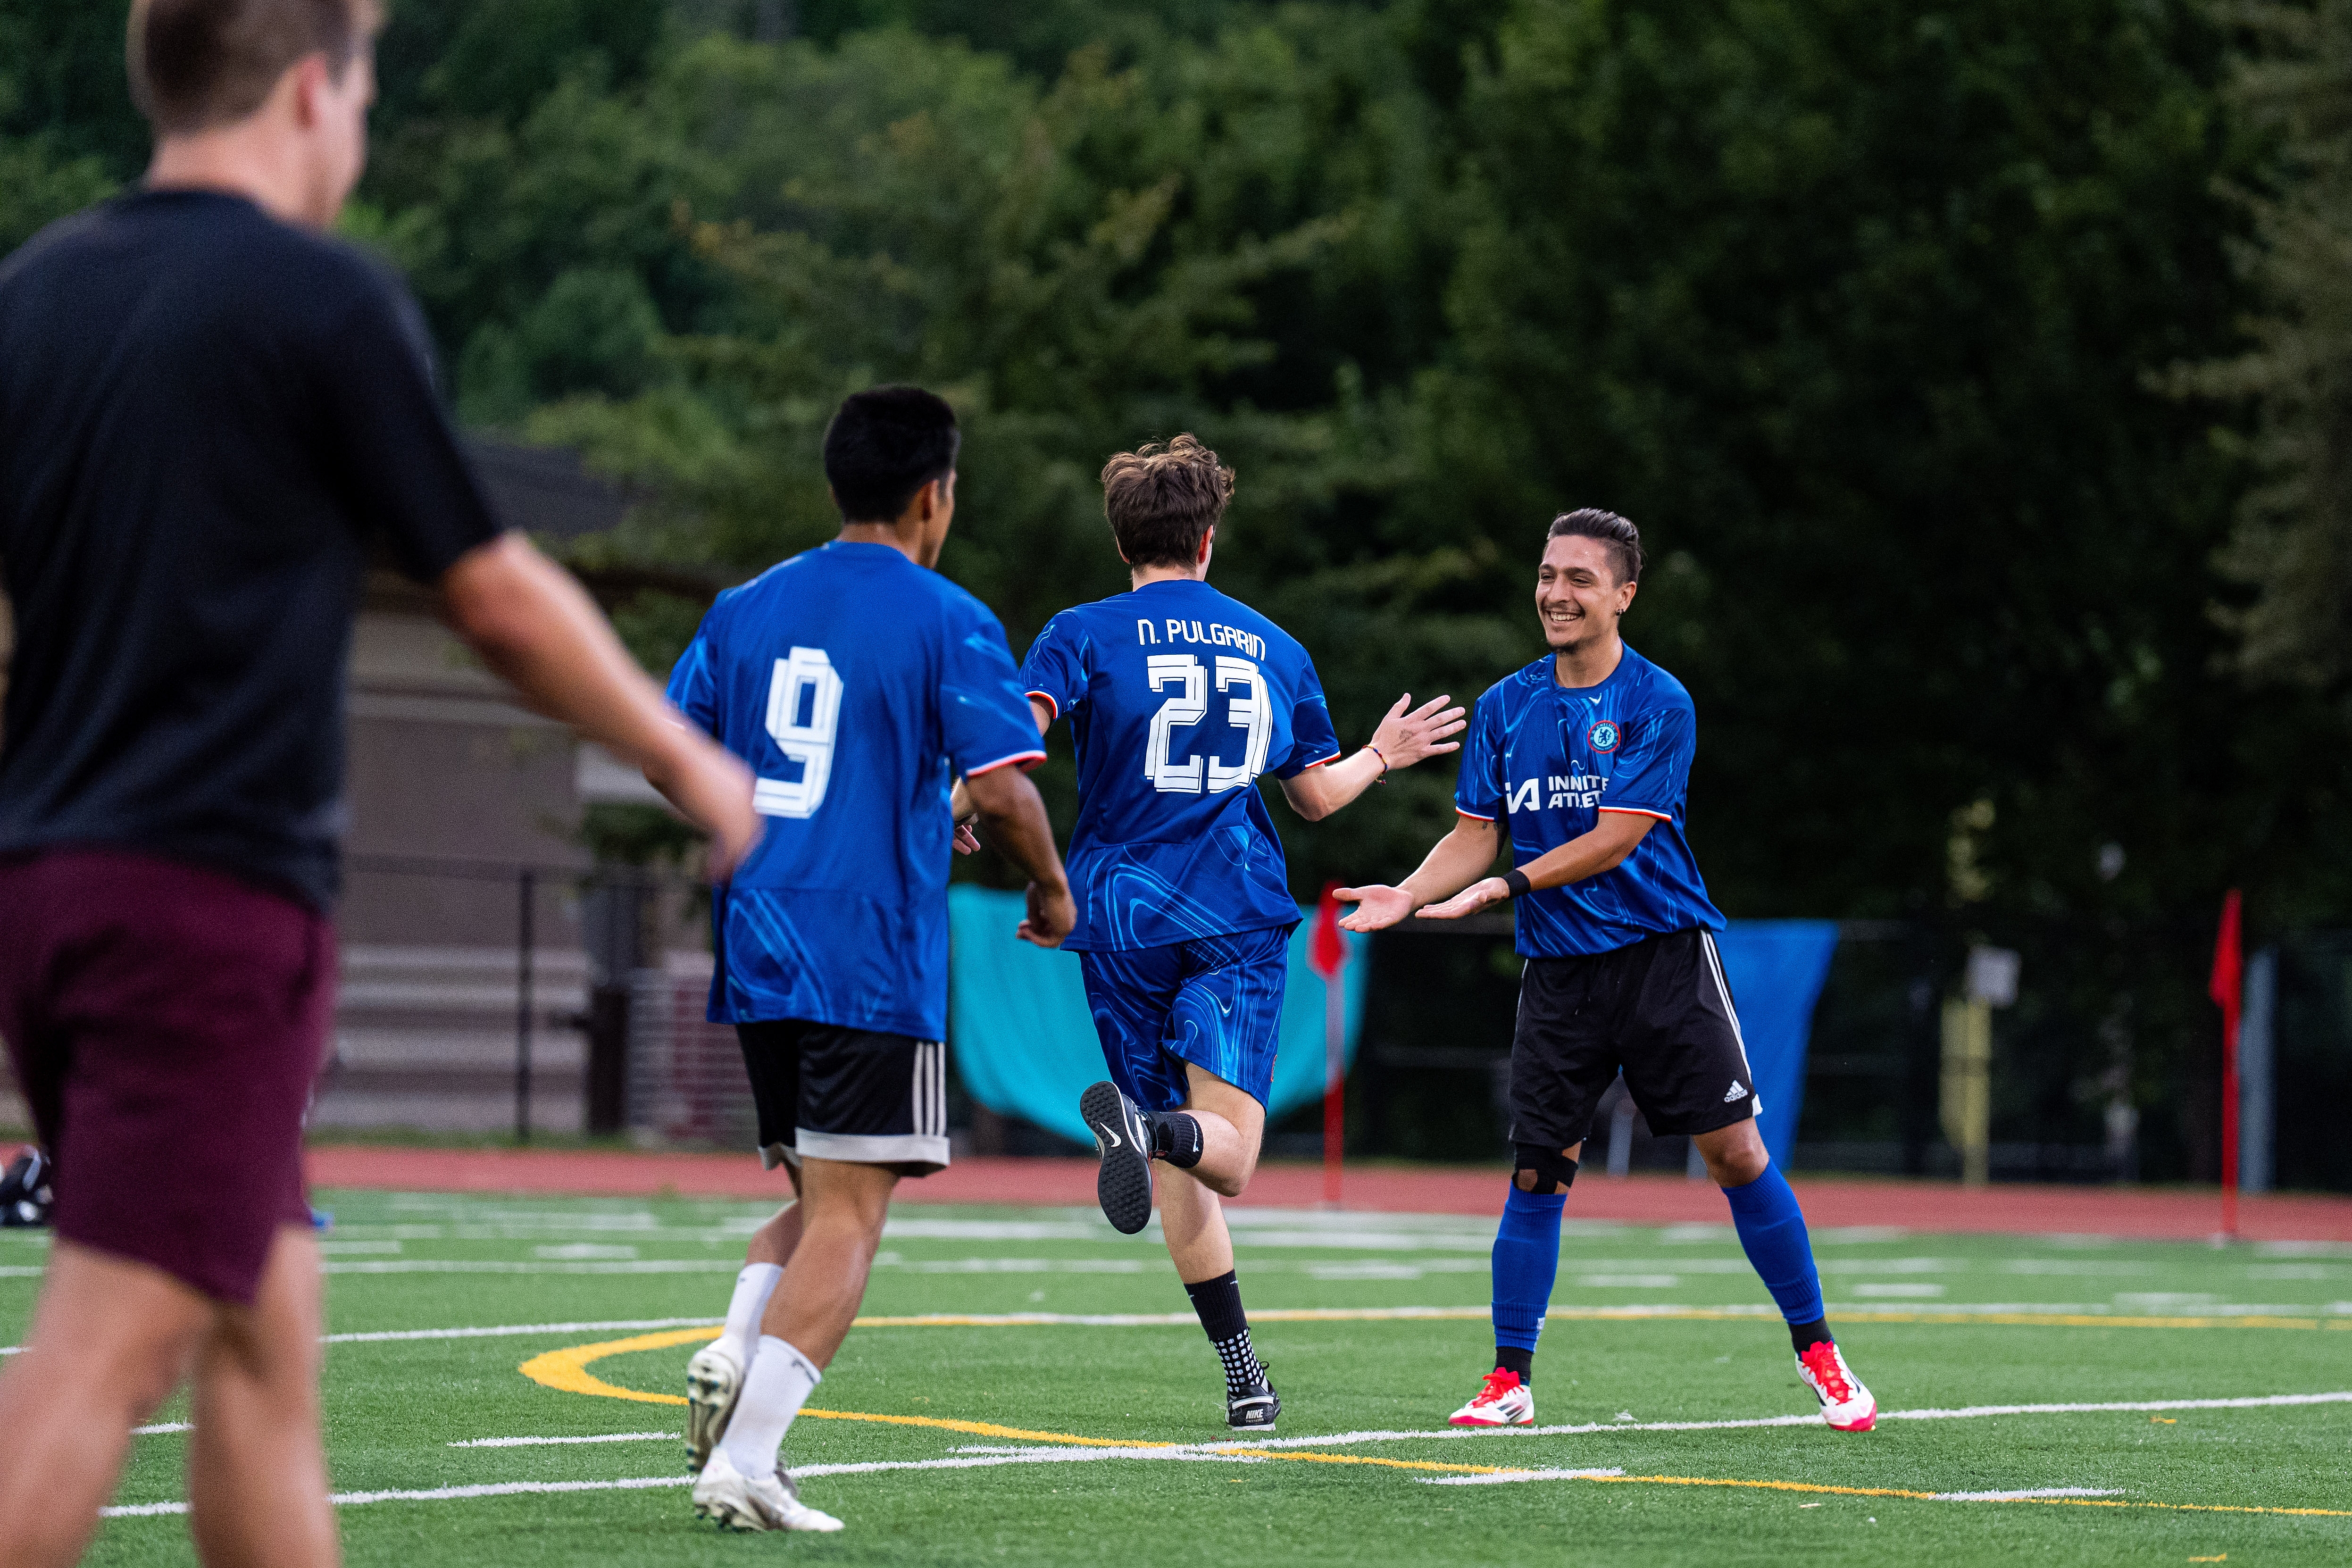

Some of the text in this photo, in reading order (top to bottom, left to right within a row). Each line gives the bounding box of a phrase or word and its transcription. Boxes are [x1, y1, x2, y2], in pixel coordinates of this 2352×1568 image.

[1137, 619, 1266, 661] N. PULGARIN
[753, 646, 844, 819] 9
[1144, 654, 1273, 794] 23
[1724, 1089, 1748, 1103] adidas
[1246, 1408, 1264, 1419] NIKE
